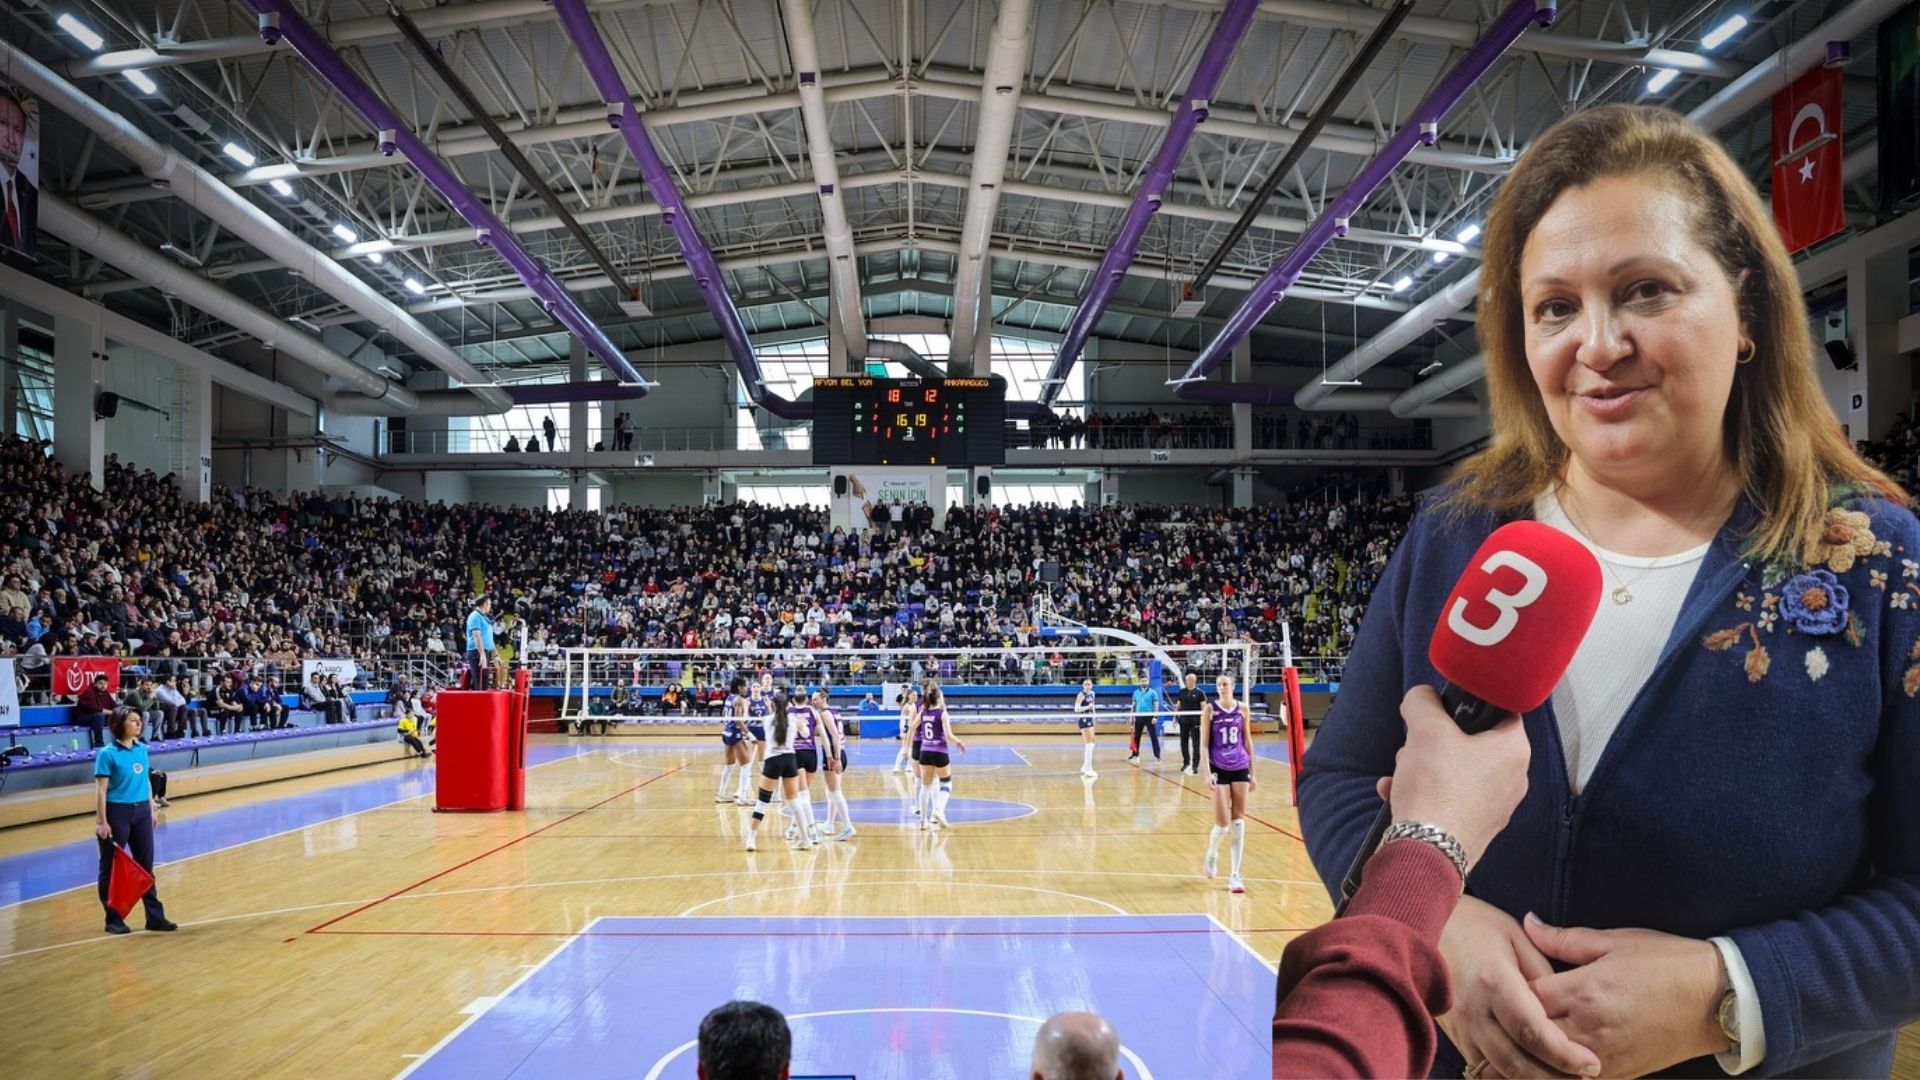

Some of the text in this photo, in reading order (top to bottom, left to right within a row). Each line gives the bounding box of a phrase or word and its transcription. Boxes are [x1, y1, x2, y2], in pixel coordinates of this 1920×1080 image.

[888, 389, 901, 403] 18
[925, 389, 937, 403] 12
[1852, 393, 1863, 410] D
[896, 413, 927, 427] 16 19
[906, 426, 913, 438] 3
[1447, 549, 1548, 646] 3
[924, 721, 934, 740] 6
[1220, 726, 1239, 745] 18
